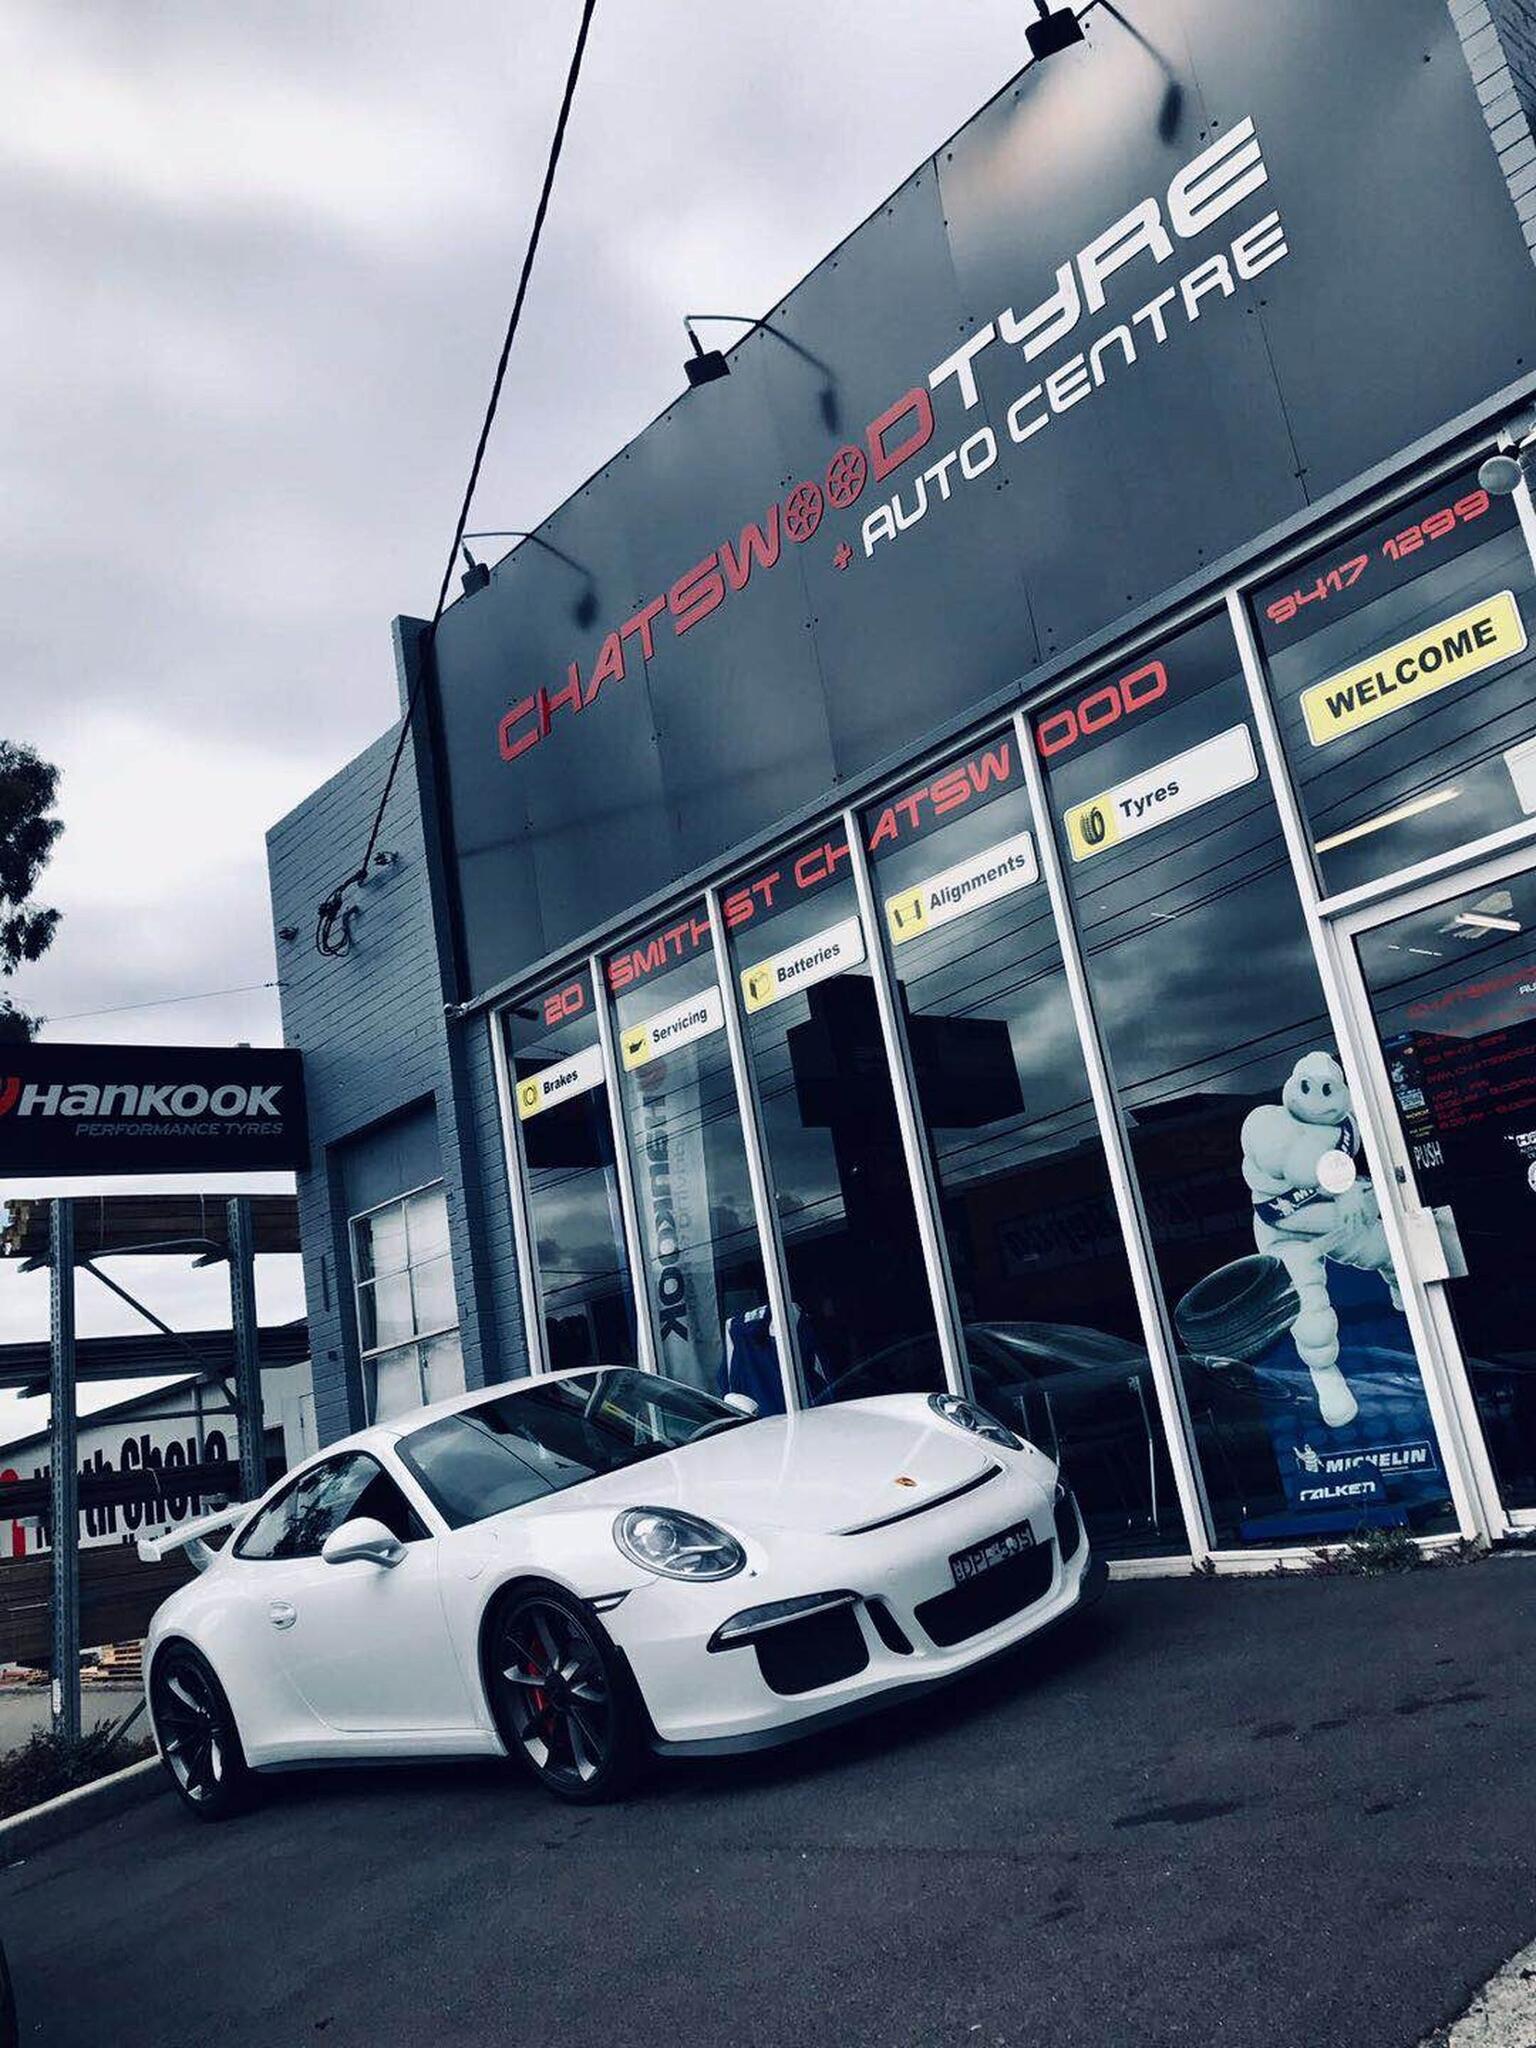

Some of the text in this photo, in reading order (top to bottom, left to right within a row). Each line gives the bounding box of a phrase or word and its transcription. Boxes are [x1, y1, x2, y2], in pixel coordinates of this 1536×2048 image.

[928, 115, 1269, 410] TYRE
[861, 425, 998, 557] AUTO
[1006, 211, 1290, 444] CENTRE
[1266, 489, 1490, 624] 9417 1299
[1325, 617, 1498, 719] WELCOME
[1120, 779, 1180, 820] Tyres
[929, 852, 1027, 910] Alignments
[544, 983, 584, 1026] 20
[607, 917, 713, 990] SMITH
[723, 873, 780, 928] ST
[777, 942, 841, 983] Batteries
[652, 1006, 708, 1043] Servicing
[543, 1068, 579, 1095] Brakes
[75, 1121, 284, 1137] PERFORMANCE TYRES
[1413, 1140, 1445, 1170] PUSH
